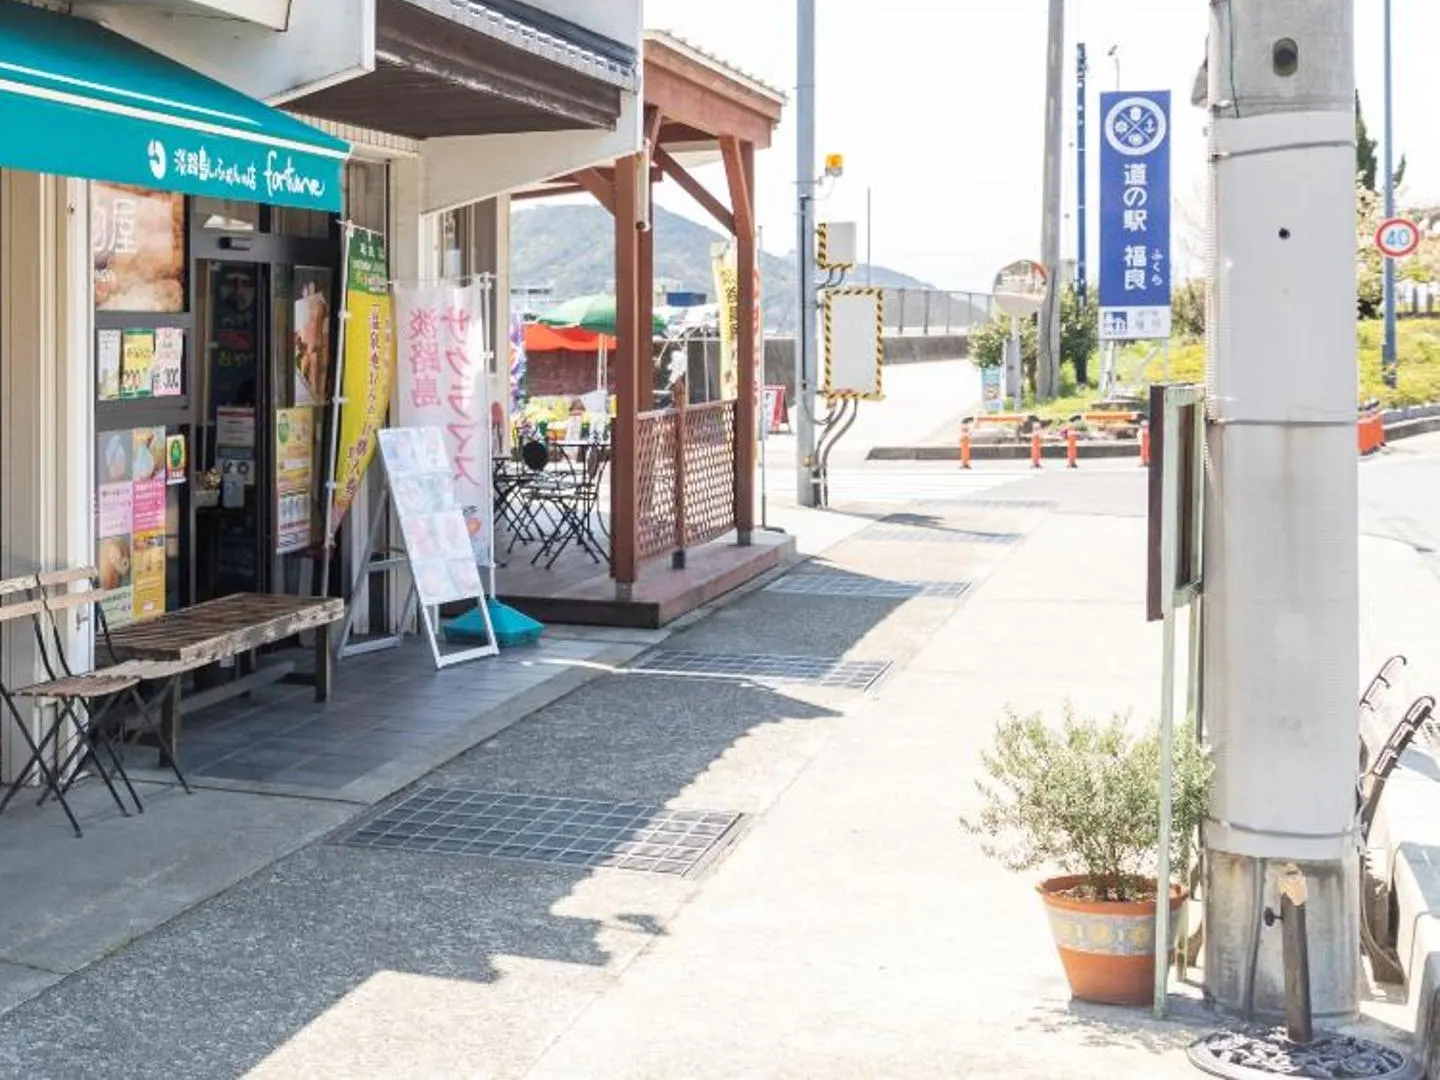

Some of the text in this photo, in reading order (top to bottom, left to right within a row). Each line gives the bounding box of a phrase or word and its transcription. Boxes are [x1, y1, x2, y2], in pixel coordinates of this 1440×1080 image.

[263, 149, 325, 198] fortune
[1123, 163, 1148, 291] 道の駅 福良
[1385, 228, 1410, 246] 40
